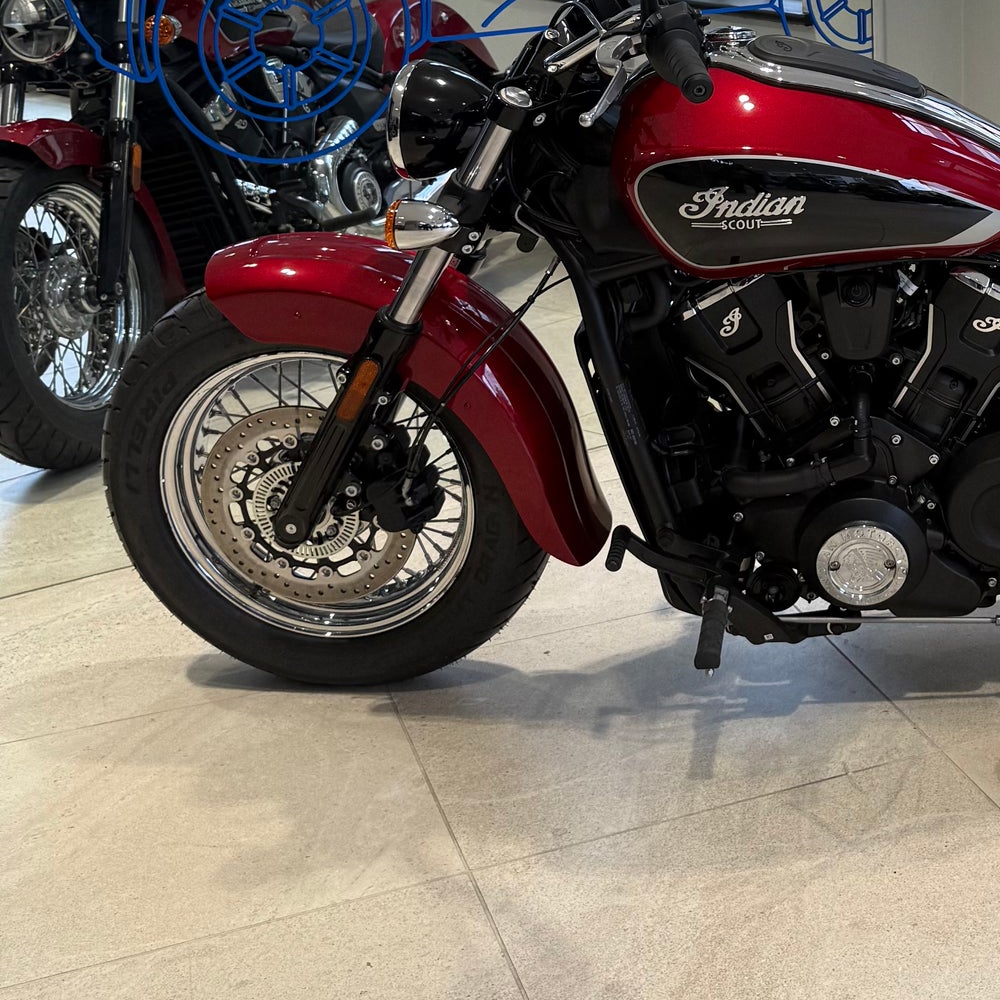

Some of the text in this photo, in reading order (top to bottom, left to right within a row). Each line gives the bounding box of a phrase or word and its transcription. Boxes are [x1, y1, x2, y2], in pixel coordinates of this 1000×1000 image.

[678, 186, 807, 219] Indian
[721, 219, 762, 230] SCOUT
[125, 370, 177, 495] PIRELLI
